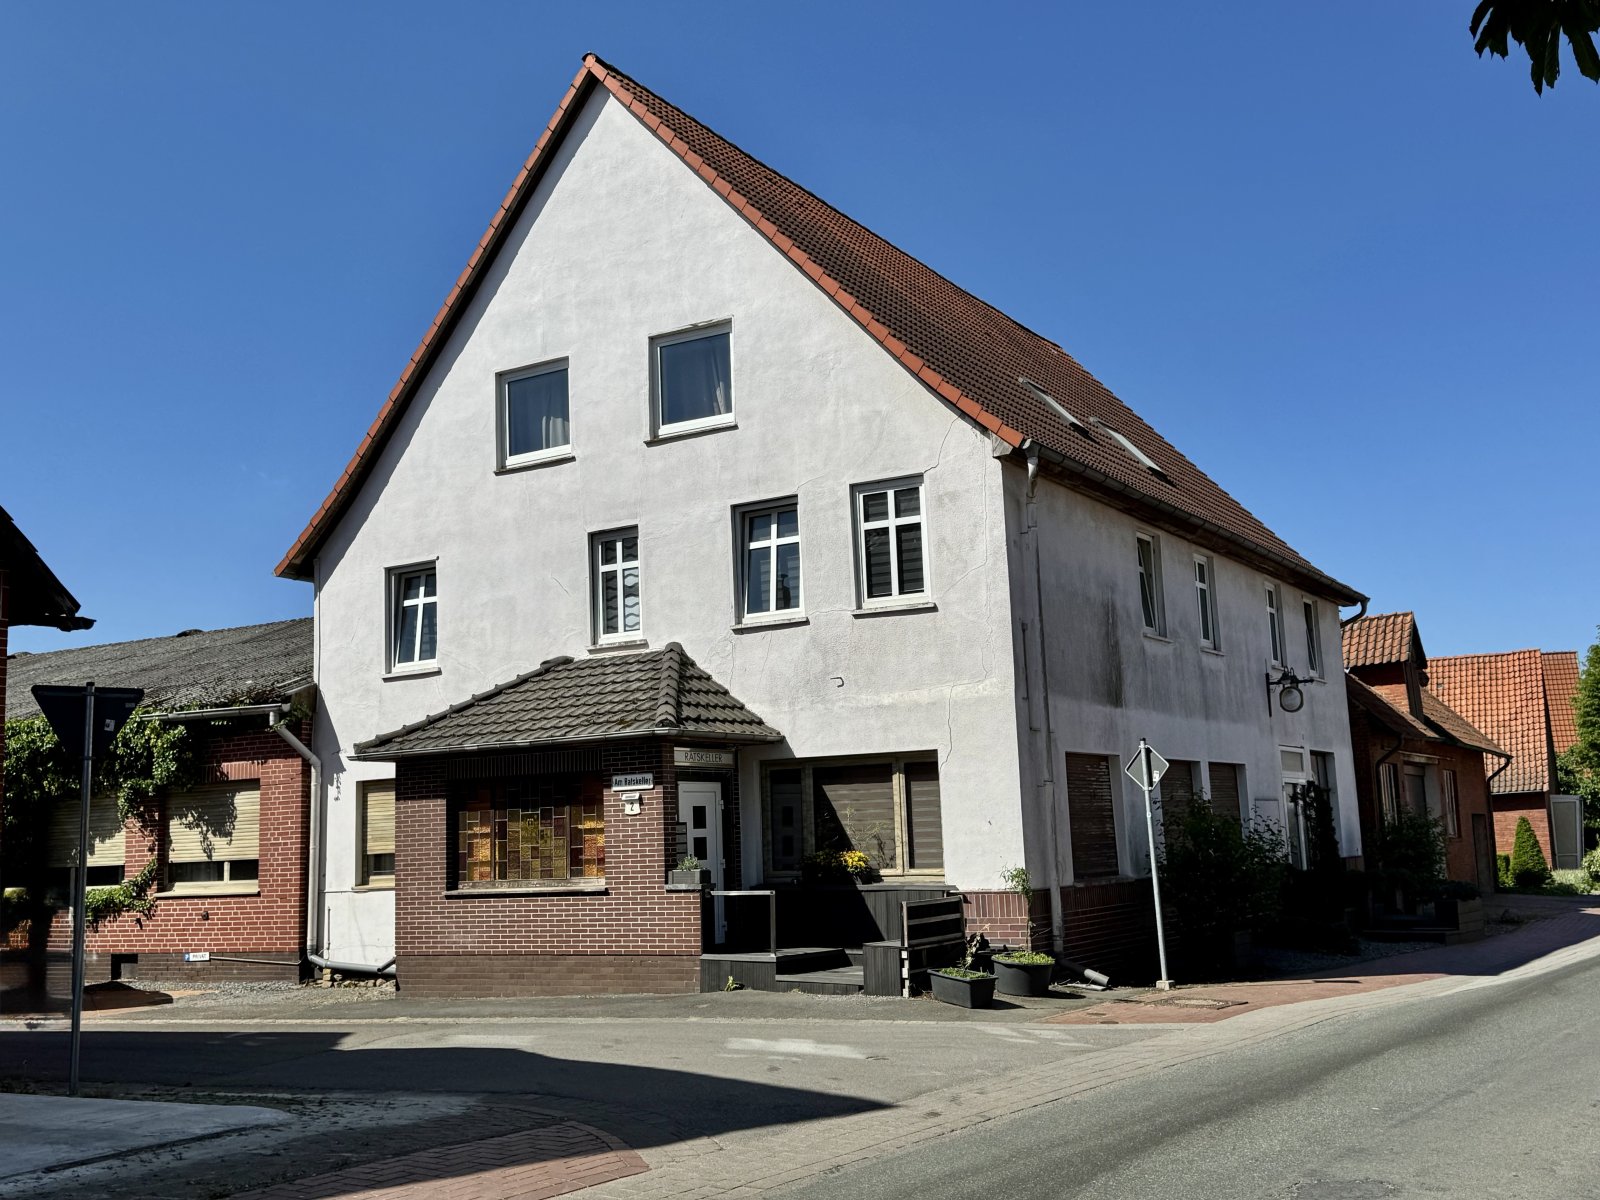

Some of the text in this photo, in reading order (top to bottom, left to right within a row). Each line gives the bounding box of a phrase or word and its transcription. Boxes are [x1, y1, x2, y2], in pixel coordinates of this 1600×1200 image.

[684, 752, 723, 763] RATSKELLER
[624, 776, 651, 786] Ratskeller
[629, 802, 634, 811] 2
